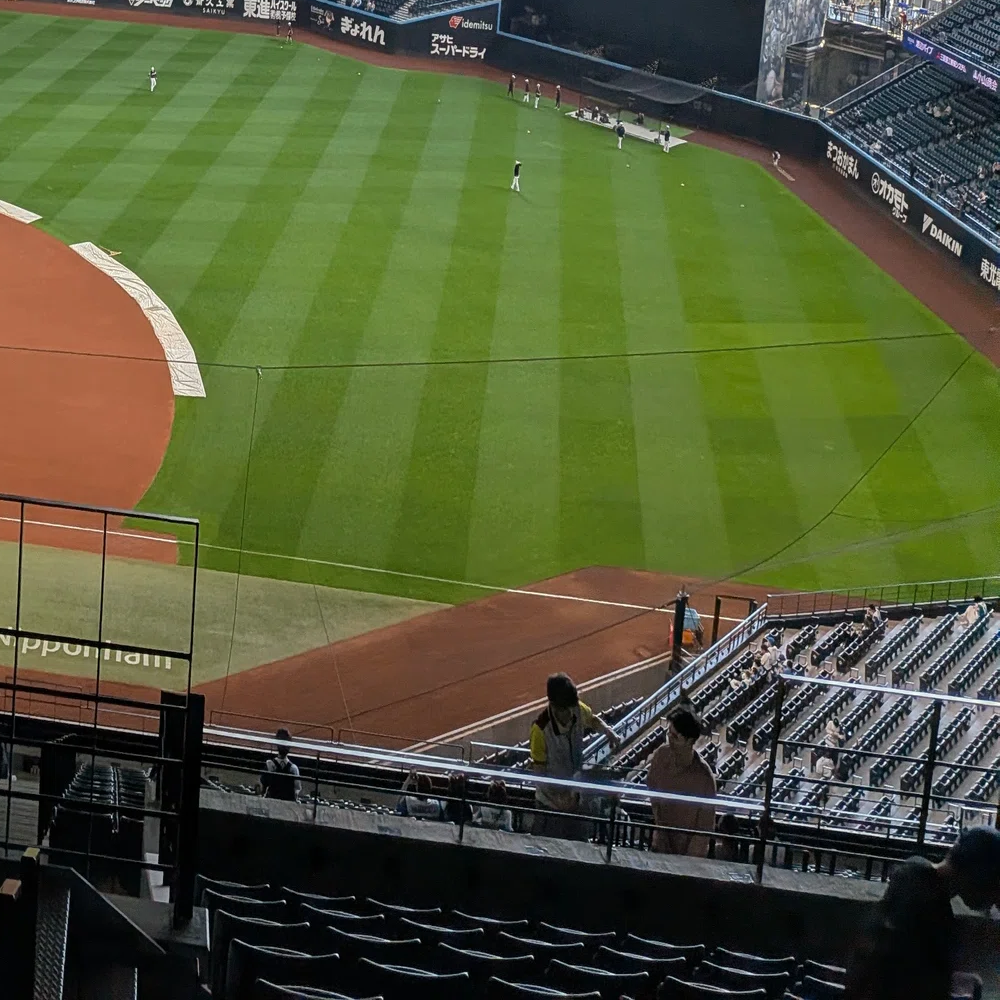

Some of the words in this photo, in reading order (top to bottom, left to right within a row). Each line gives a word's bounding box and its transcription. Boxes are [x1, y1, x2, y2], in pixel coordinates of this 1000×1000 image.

[203, 8, 226, 16] SAIKYU
[340, 15, 386, 46] ぎょれん
[461, 20, 493, 31] idemitsu
[431, 33, 454, 44] アサヒ
[430, 44, 487, 60] スーパードライ
[879, 179, 909, 212] オカモト
[930, 224, 963, 257] DAIKIN
